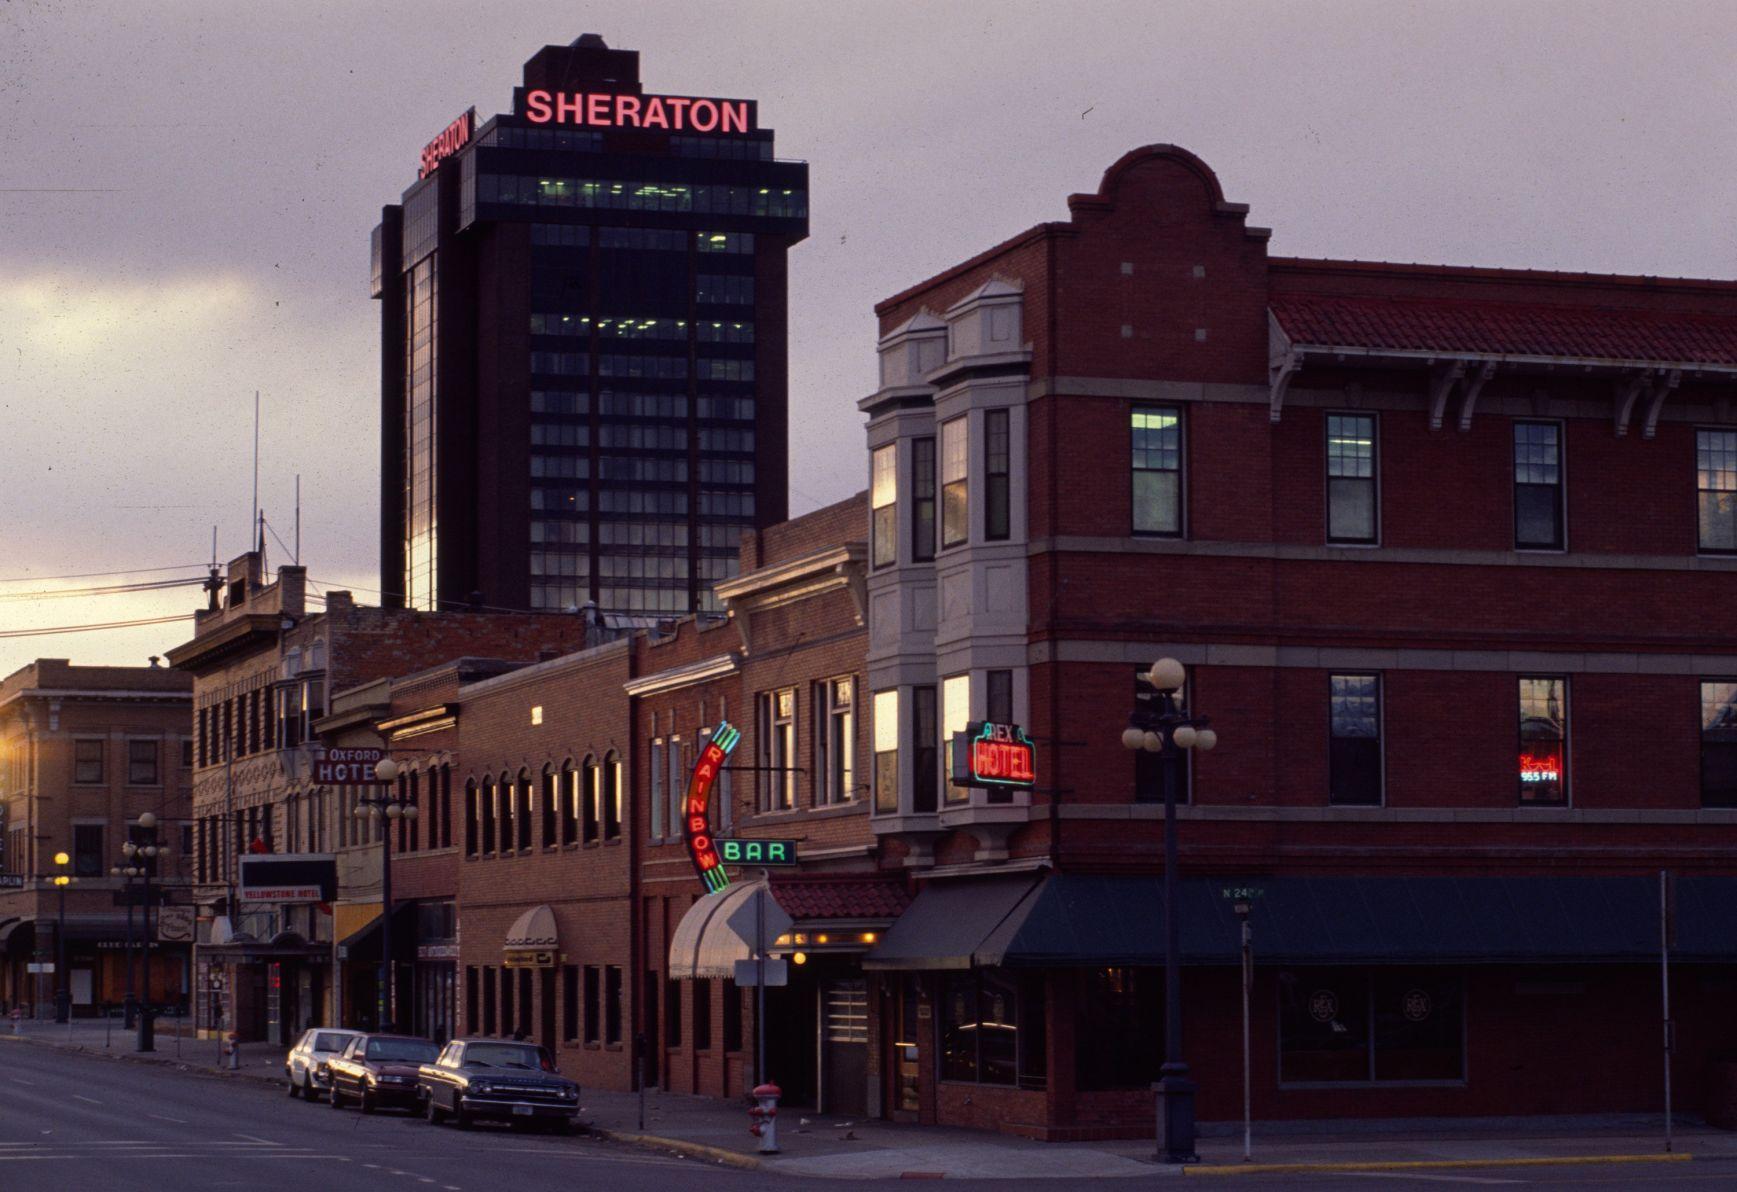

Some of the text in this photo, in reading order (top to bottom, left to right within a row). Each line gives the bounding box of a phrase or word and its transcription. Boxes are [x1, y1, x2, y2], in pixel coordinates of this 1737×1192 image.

[526, 90, 748, 133] SHERATON
[419, 111, 469, 180] SHERATON
[988, 724, 1013, 743] REX
[329, 748, 380, 761] OXFORD
[977, 741, 1034, 779] HOTEL
[319, 763, 375, 781] HOTE
[690, 747, 722, 870] RAINBOW
[724, 842, 785, 861] BAR
[245, 888, 320, 899] YELLOWSTONE HOTEL
